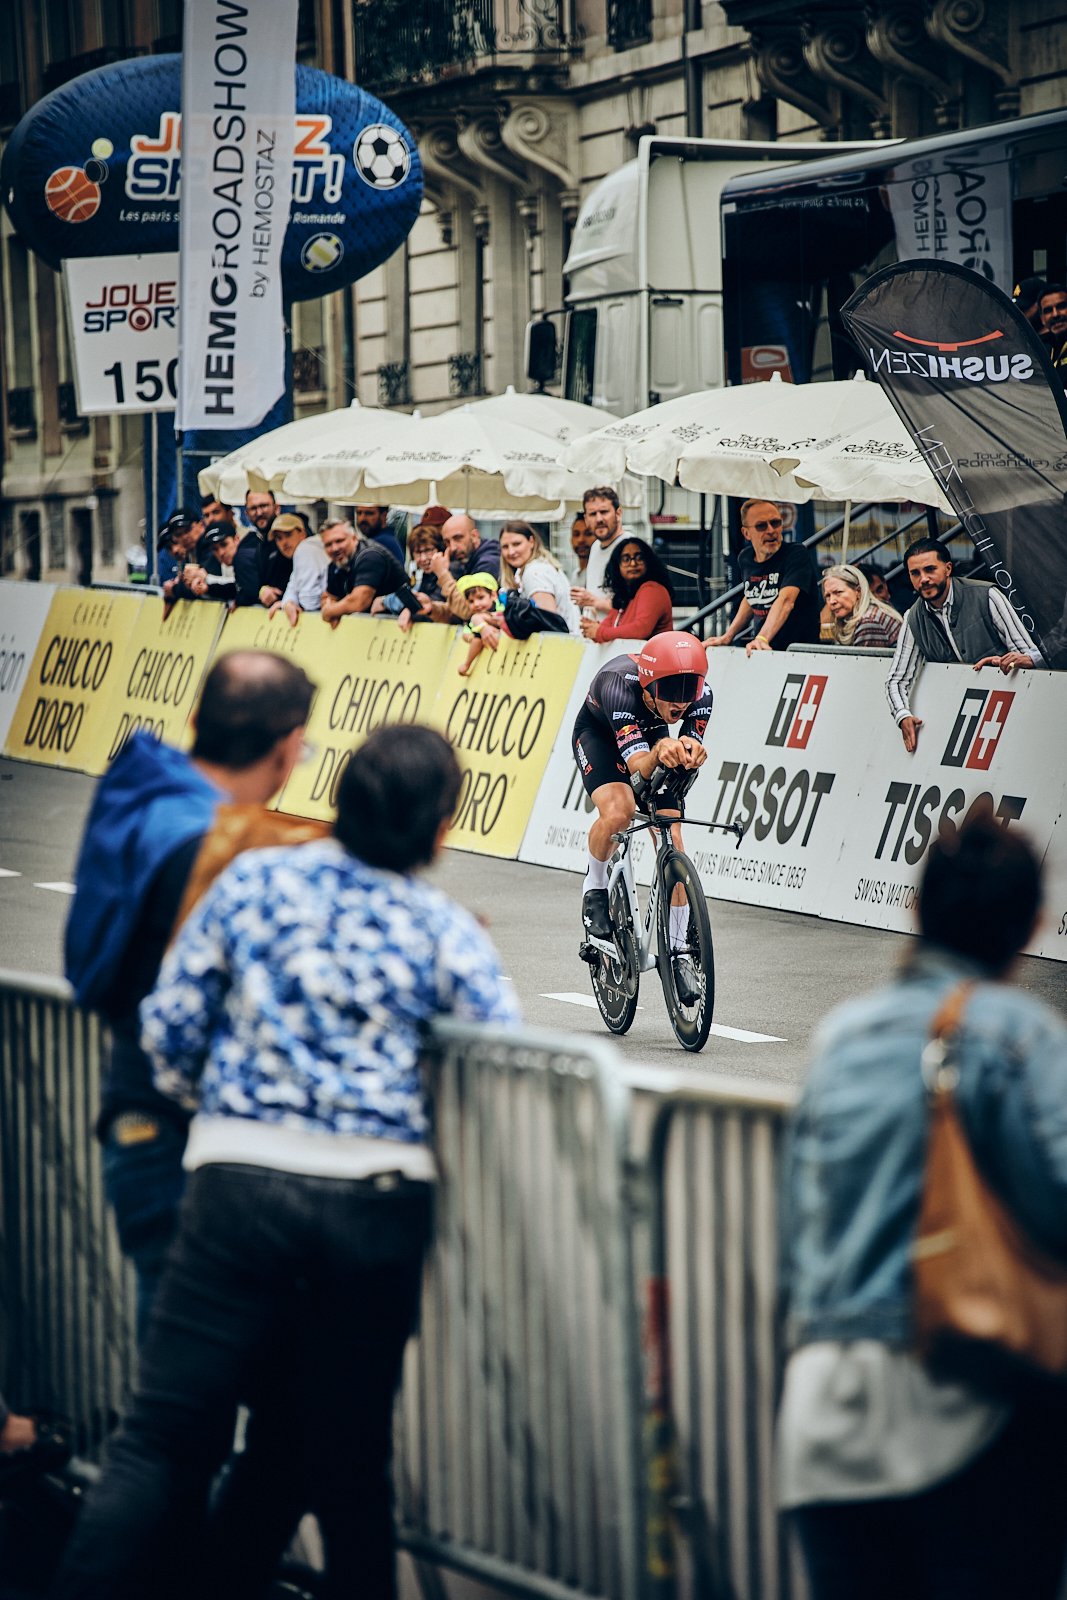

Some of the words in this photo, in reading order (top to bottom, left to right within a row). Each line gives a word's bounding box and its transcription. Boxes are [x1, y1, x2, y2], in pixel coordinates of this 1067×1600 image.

[251, 129, 277, 265] HEMOSTAZ
[249, 272, 267, 298] by
[84, 305, 180, 332] SPOR
[974, 452, 1003, 460] Tour
[40, 634, 114, 692] CHICCO
[127, 647, 195, 707] CHICCO
[446, 688, 546, 760] CHICCO
[708, 761, 836, 847] TISSOT
[693, 850, 716, 875] SWISS
[717, 854, 757, 881] WATCHES
[757, 861, 786, 887] SINCE
[784, 866, 807, 890] 1853
[854, 877, 886, 905] SWISS
[885, 883, 921, 911] WATCH
